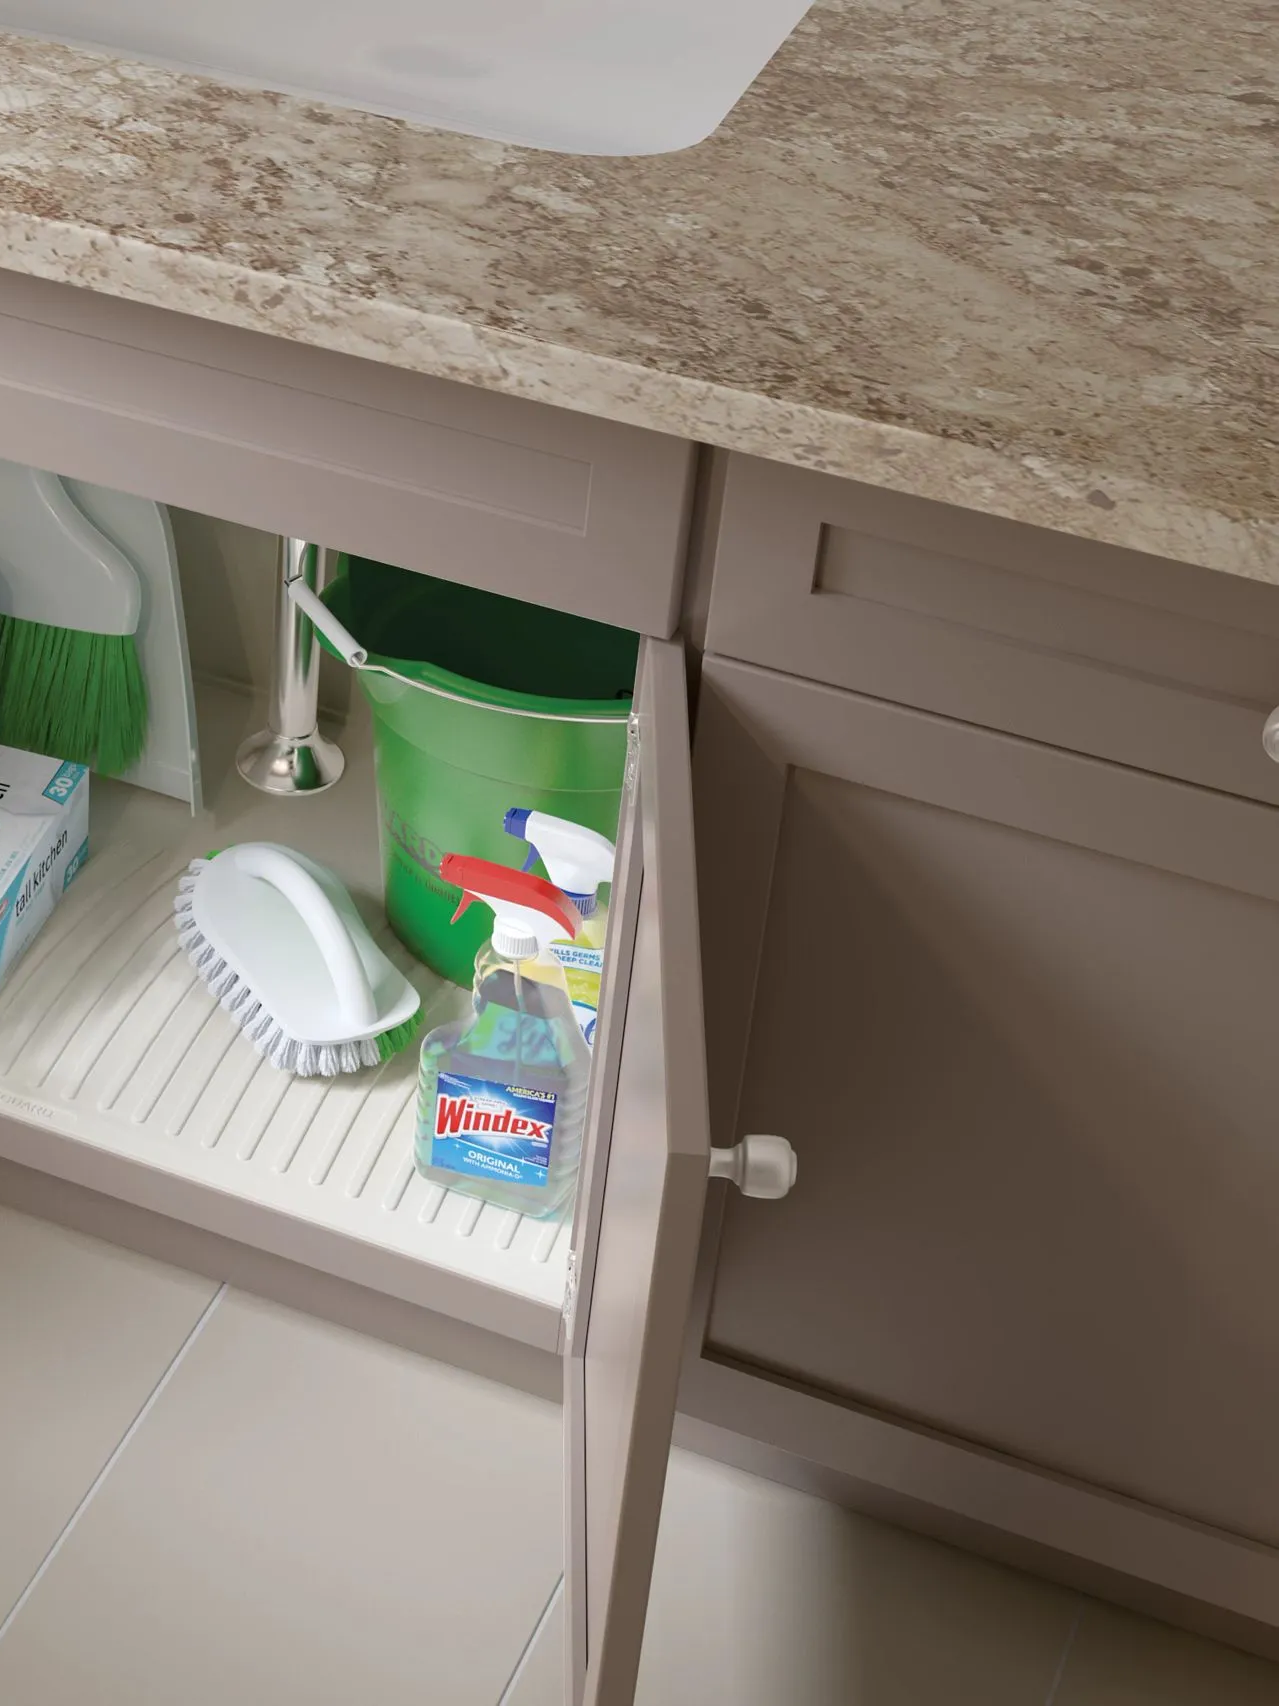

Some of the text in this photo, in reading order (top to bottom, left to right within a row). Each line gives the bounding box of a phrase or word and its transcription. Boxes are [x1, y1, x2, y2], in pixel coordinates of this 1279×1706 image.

[48, 777, 74, 797] 30
[16, 880, 32, 917] tall
[33, 829, 68, 888] kitchen
[572, 951, 601, 960] GERMS
[579, 958, 603, 967] CLEA
[436, 1096, 547, 1140] Windex
[468, 1150, 521, 1174] ORIGINAL
